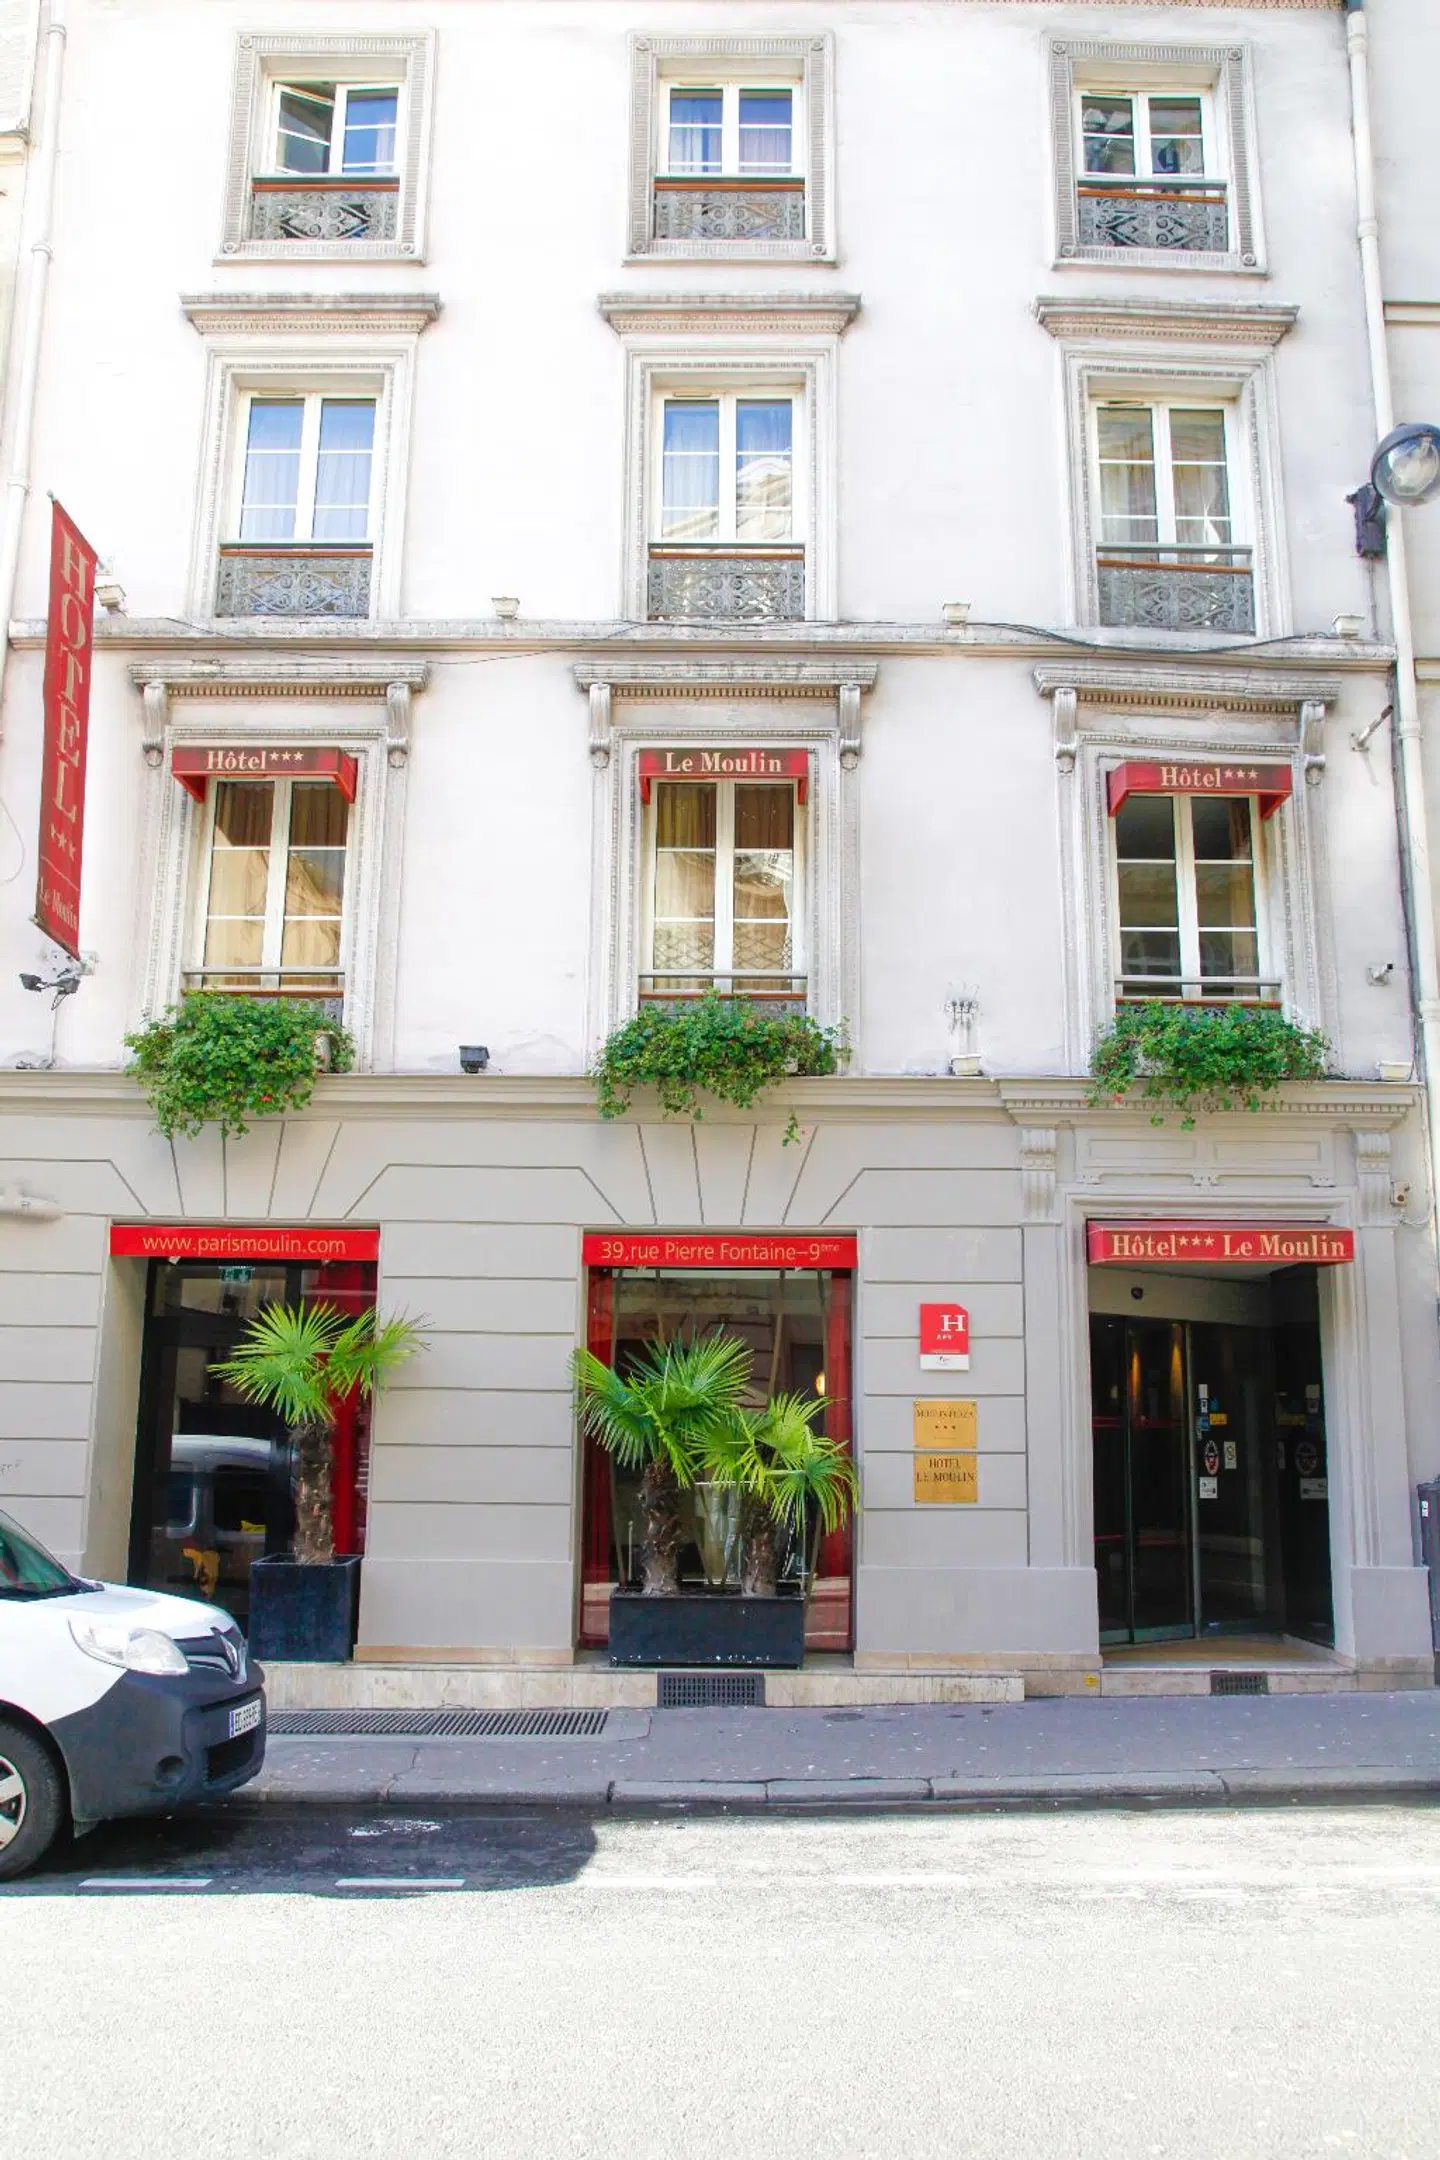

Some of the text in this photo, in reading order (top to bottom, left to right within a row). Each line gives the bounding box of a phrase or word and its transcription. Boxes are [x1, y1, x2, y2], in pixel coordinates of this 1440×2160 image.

[54, 525, 90, 824] HOTEL
[206, 750, 266, 770] Hôtel
[664, 752, 782, 772] Le Moulin
[1159, 766, 1223, 788] Hôtel
[142, 1233, 346, 1255] www.parismoulin.com
[665, 1242, 714, 1260] Pierre
[1111, 1234, 1346, 1257] Hôtel Le Moulin
[940, 1314, 966, 1332] H
[933, 1472, 976, 1482] MOULIN
